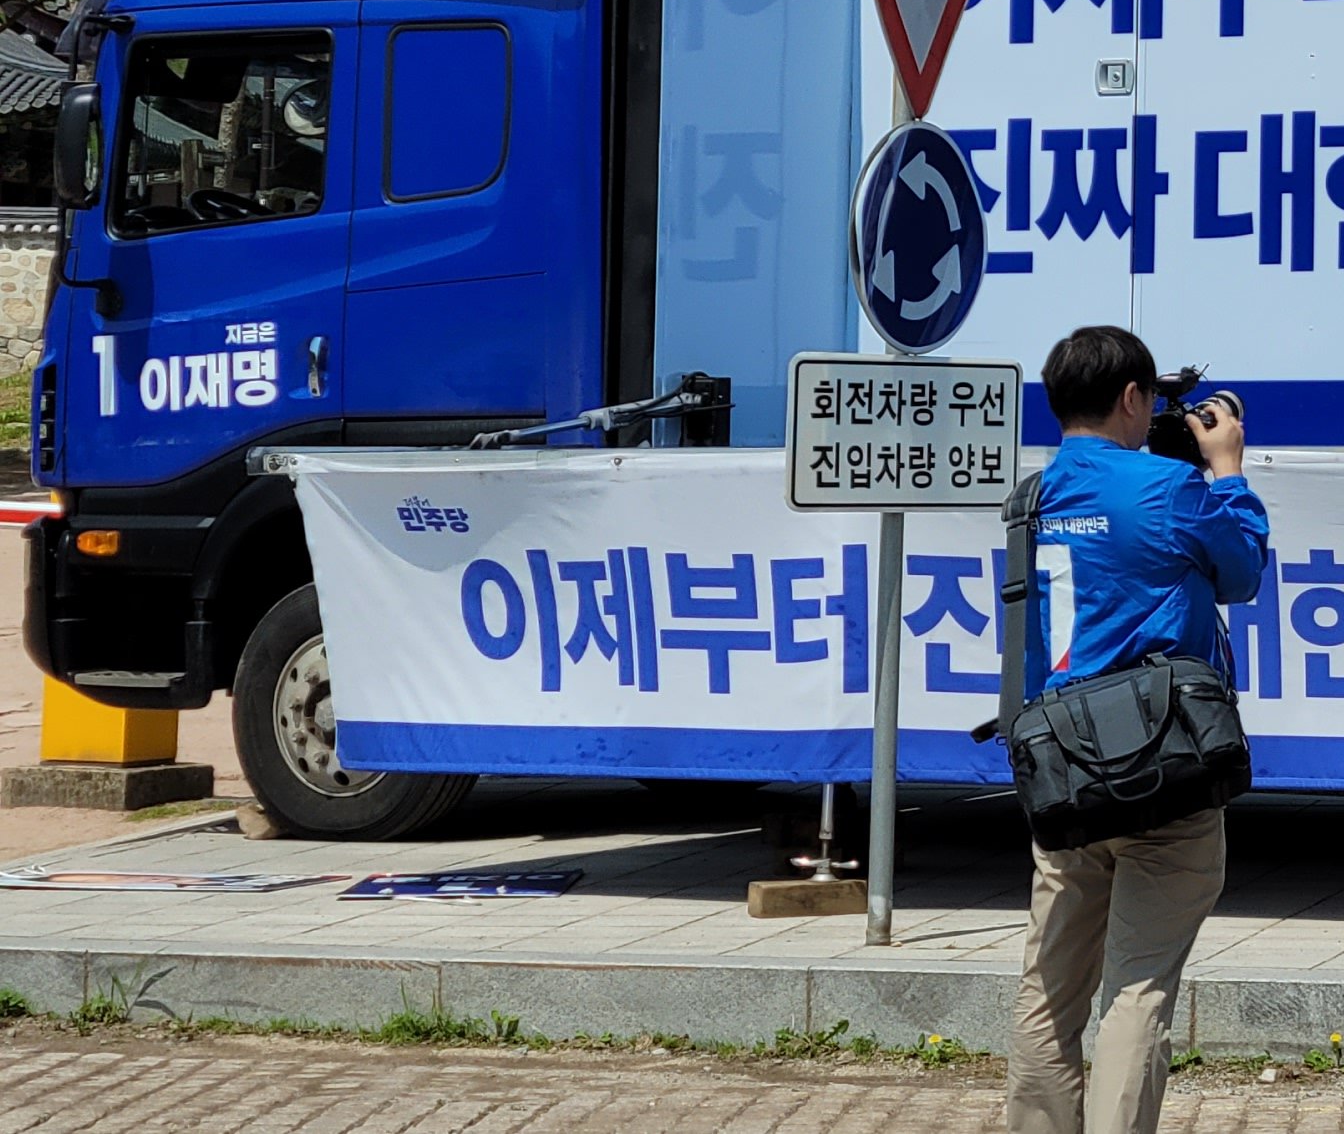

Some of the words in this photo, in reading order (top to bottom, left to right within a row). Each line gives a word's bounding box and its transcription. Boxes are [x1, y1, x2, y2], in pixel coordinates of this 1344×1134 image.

[225, 321, 276, 345] 지금은
[91, 334, 118, 416] 1
[139, 351, 278, 412] 이재명
[809, 377, 938, 427] 회전차량
[948, 380, 1006, 427] 우선
[809, 441, 937, 490] 진입차량
[947, 444, 1006, 488] 양보
[396, 507, 470, 534] 민주당
[1040, 517, 1064, 534] 진짜
[1065, 516, 1110, 534] 대한민국
[460, 545, 869, 695] 이제부터
[1035, 544, 1076, 672] 1
